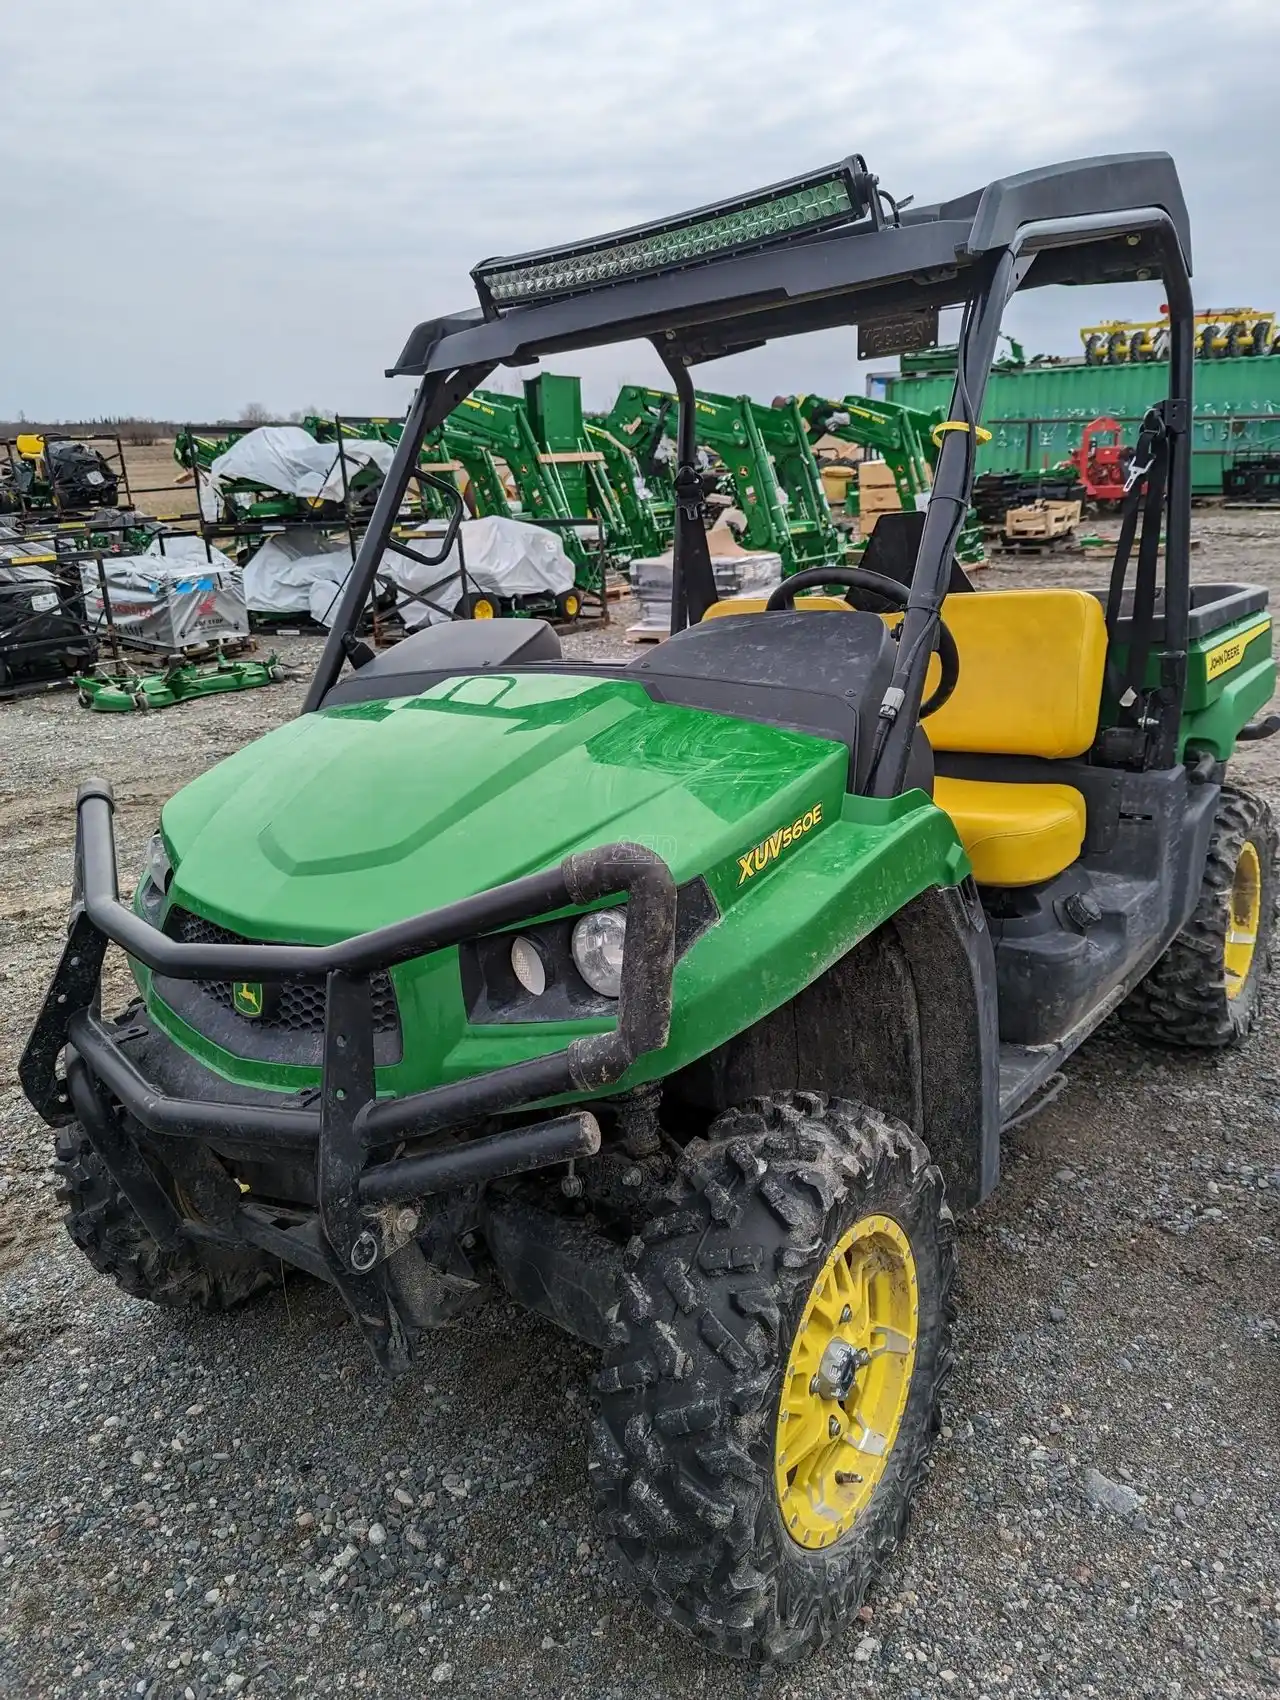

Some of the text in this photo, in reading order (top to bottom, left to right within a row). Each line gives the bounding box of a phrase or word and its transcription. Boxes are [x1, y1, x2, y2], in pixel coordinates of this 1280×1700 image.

[1210, 644, 1240, 671] JOHN DEERE
[737, 801, 823, 887] XUV560E
